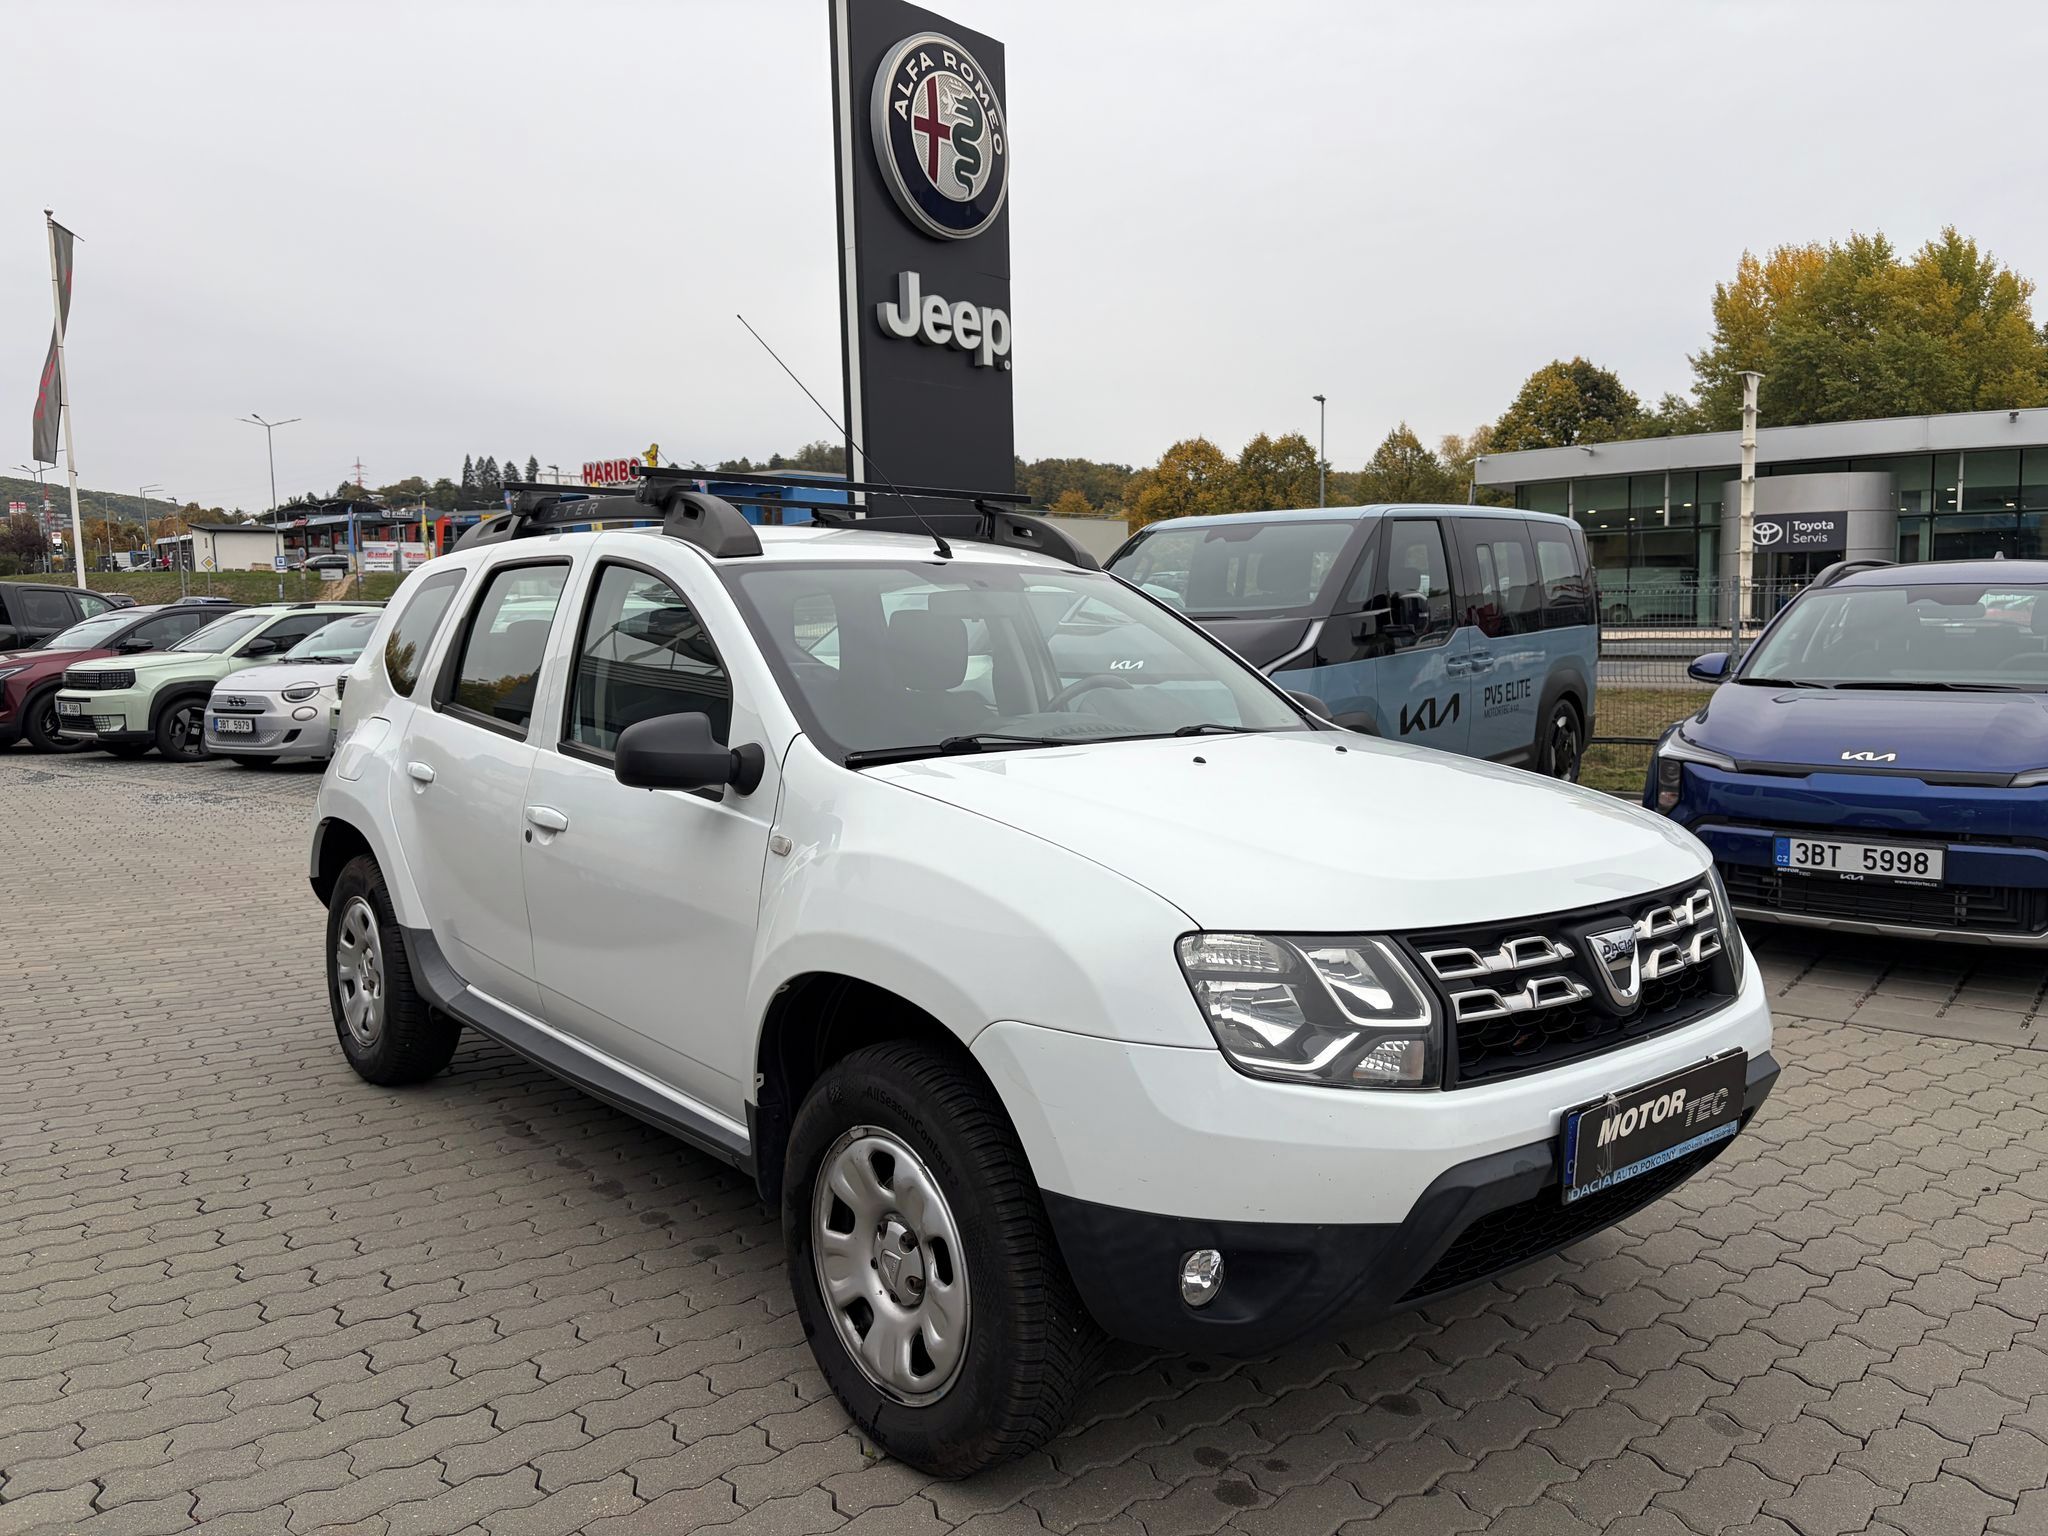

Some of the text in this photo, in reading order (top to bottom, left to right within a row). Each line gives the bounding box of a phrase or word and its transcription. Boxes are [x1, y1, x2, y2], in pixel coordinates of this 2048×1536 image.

[895, 50, 1003, 155] ALFA ROMEO
[877, 271, 1011, 367] Jeep
[583, 457, 641, 485] HARIBO
[1793, 520, 1834, 532] Toyota
[1793, 533, 1828, 543] Servis
[1484, 678, 1531, 708] PV5 ELITE
[1400, 692, 1460, 735] KIA
[1841, 751, 1896, 762] KIA
[1776, 843, 1929, 875] CZ 3BT 5998
[1603, 939, 1634, 955] DACIA
[1597, 1088, 1687, 1148] MOTOR
[1571, 1174, 1612, 1201] DACIA
[1616, 1163, 1639, 1181] AUTO
